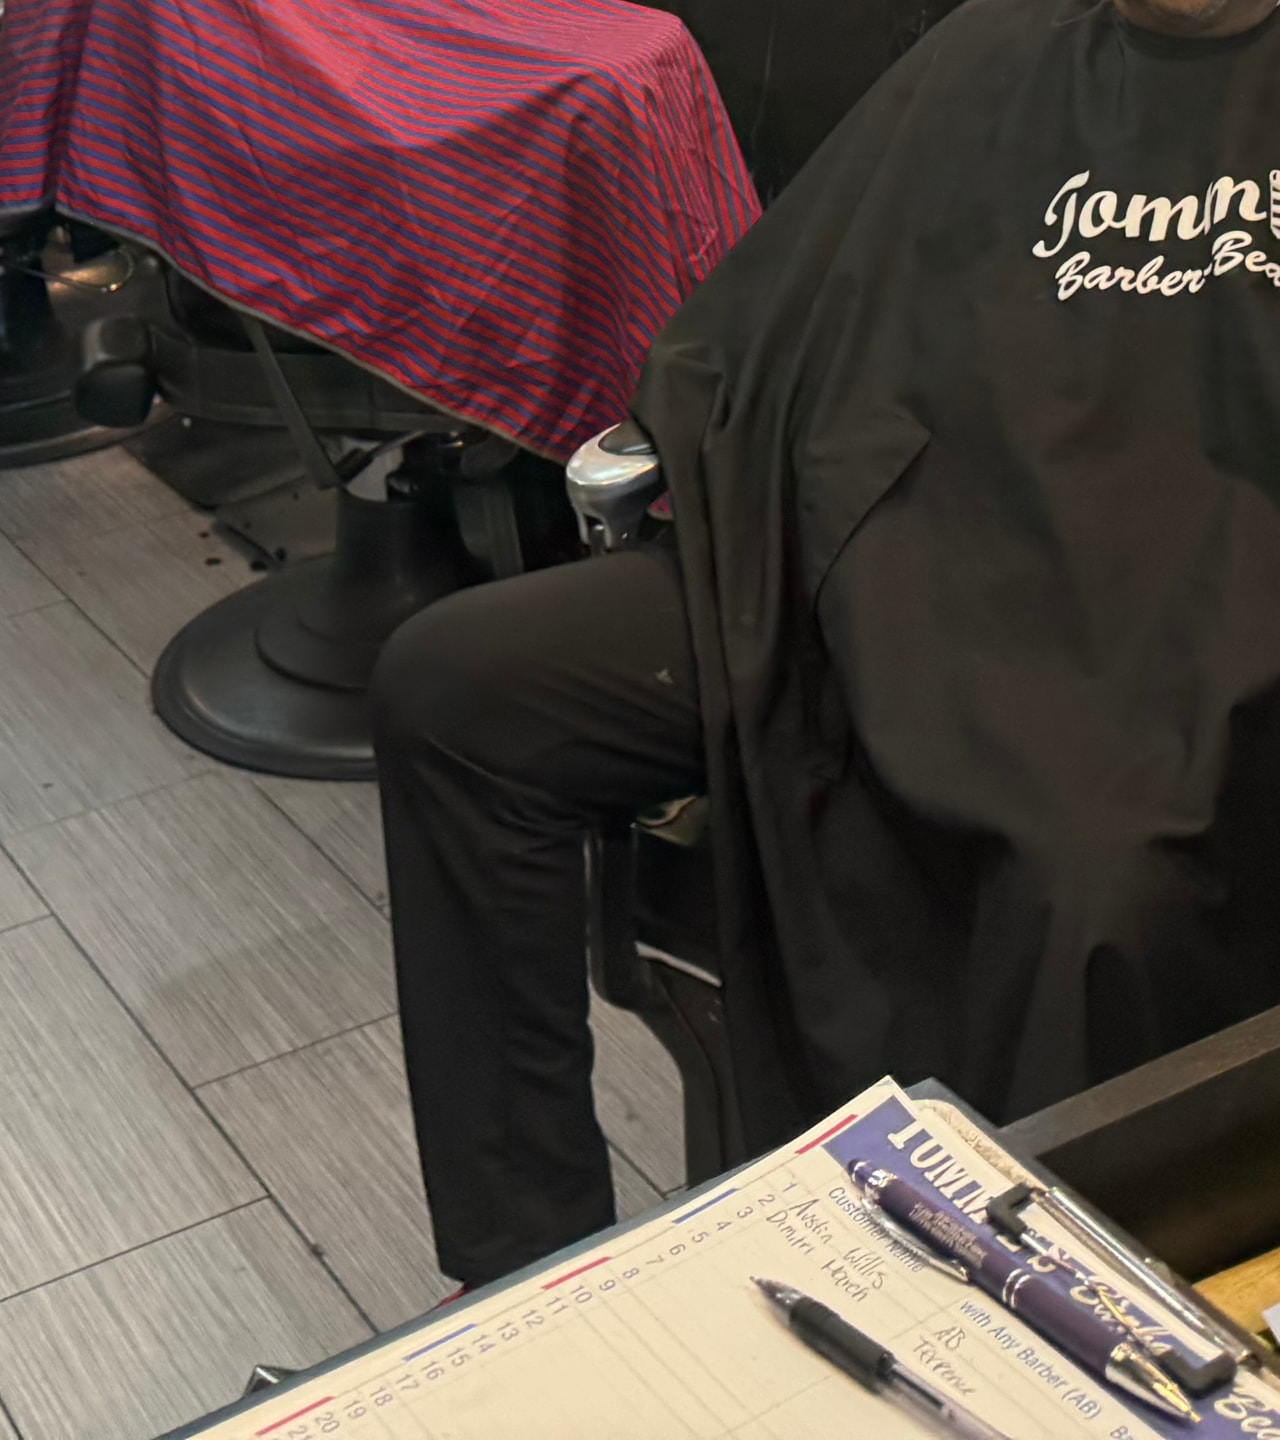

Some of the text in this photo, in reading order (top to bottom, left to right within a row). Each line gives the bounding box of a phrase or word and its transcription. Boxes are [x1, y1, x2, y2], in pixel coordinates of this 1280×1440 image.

[757, 1193, 776, 1207] 2
[736, 1206, 754, 1219] 3
[716, 1219, 732, 1232] 4
[691, 1231, 709, 1245] 5
[669, 1243, 687, 1256] 6
[645, 1255, 664, 1267] 7
[622, 1267, 641, 1280] 8
[569, 1285, 593, 1305] 10
[599, 1279, 616, 1293] 9
[547, 1296, 569, 1315] 11
[522, 1309, 545, 1329] 12
[497, 1321, 520, 1342] 13
[471, 1333, 496, 1355] 14
[446, 1347, 471, 1369] 15
[960, 1300, 993, 1328] with
[987, 1325, 1021, 1351] Any
[1016, 1346, 1071, 1390] Barber
[1061, 1387, 1103, 1420] (AB)
[420, 1360, 446, 1382] 16
[395, 1373, 420, 1393] 17
[370, 1386, 394, 1408] 18
[343, 1399, 367, 1421] 19
[315, 1411, 341, 1435] 20
